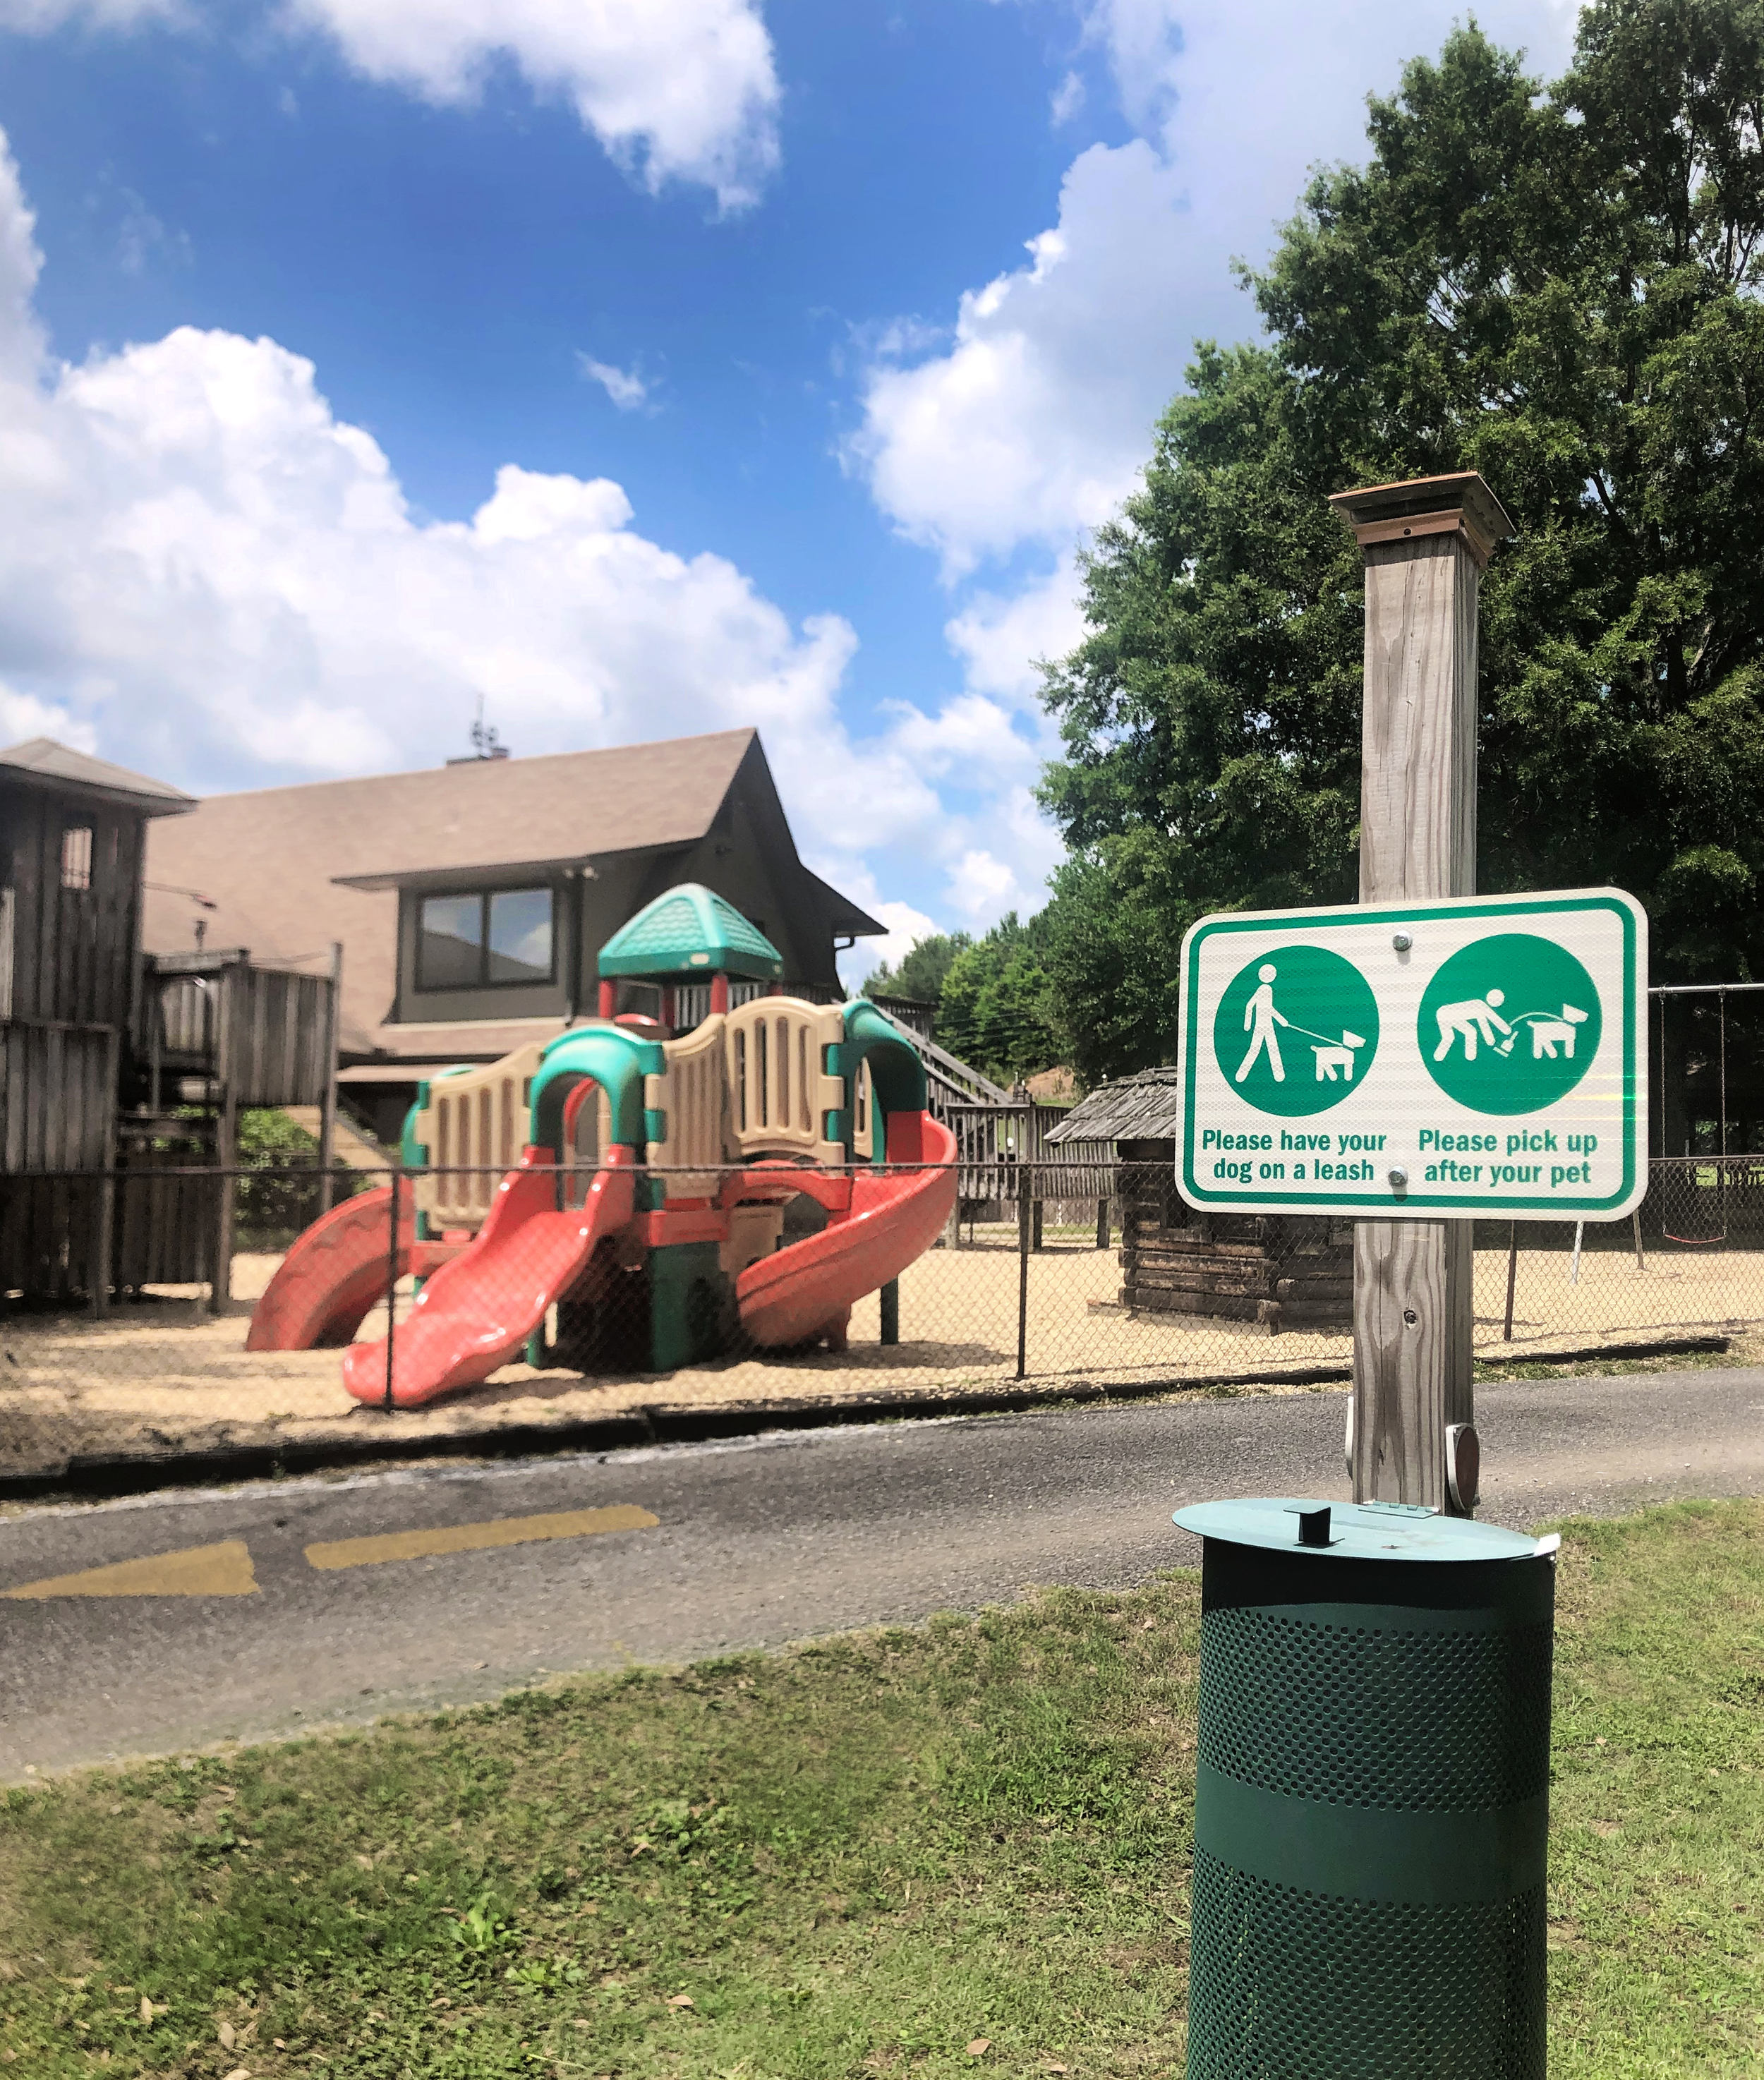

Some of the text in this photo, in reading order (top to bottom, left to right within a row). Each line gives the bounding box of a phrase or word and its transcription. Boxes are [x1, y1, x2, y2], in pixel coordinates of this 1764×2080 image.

[1202, 1130, 1387, 1156] Please have your
[1418, 1129, 1598, 1158] Please pick up
[1213, 1158, 1375, 1185] dog on a leash
[1424, 1159, 1591, 1189] after your pet
